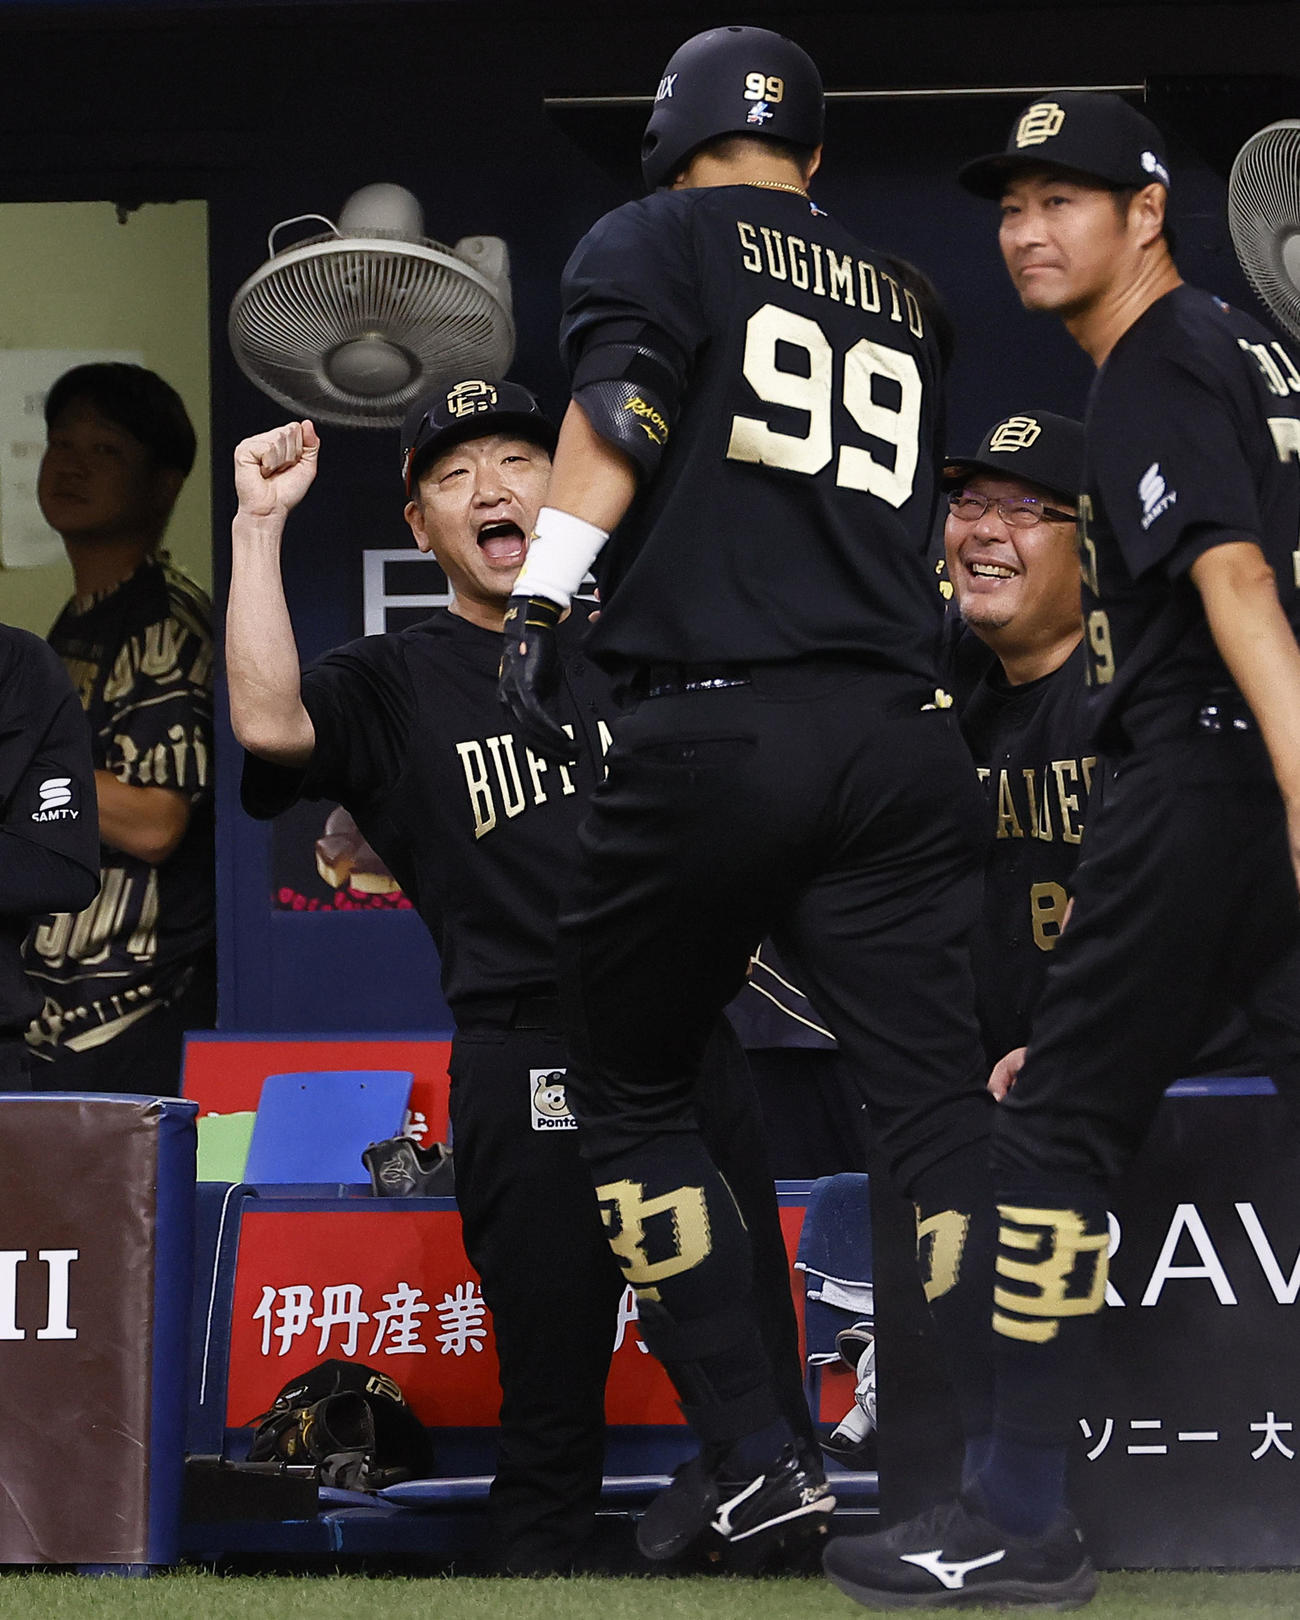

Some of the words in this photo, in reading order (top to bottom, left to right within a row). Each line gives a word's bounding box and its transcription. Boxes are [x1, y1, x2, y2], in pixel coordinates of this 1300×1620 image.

[744, 72, 785, 103] 99
[737, 221, 924, 339] SUGIMOTO
[726, 303, 923, 509] 99
[31, 809, 79, 822] SAMTY
[252, 1282, 488, 1357] 伊丹産業
[1078, 1418, 1219, 1462] ソニー
